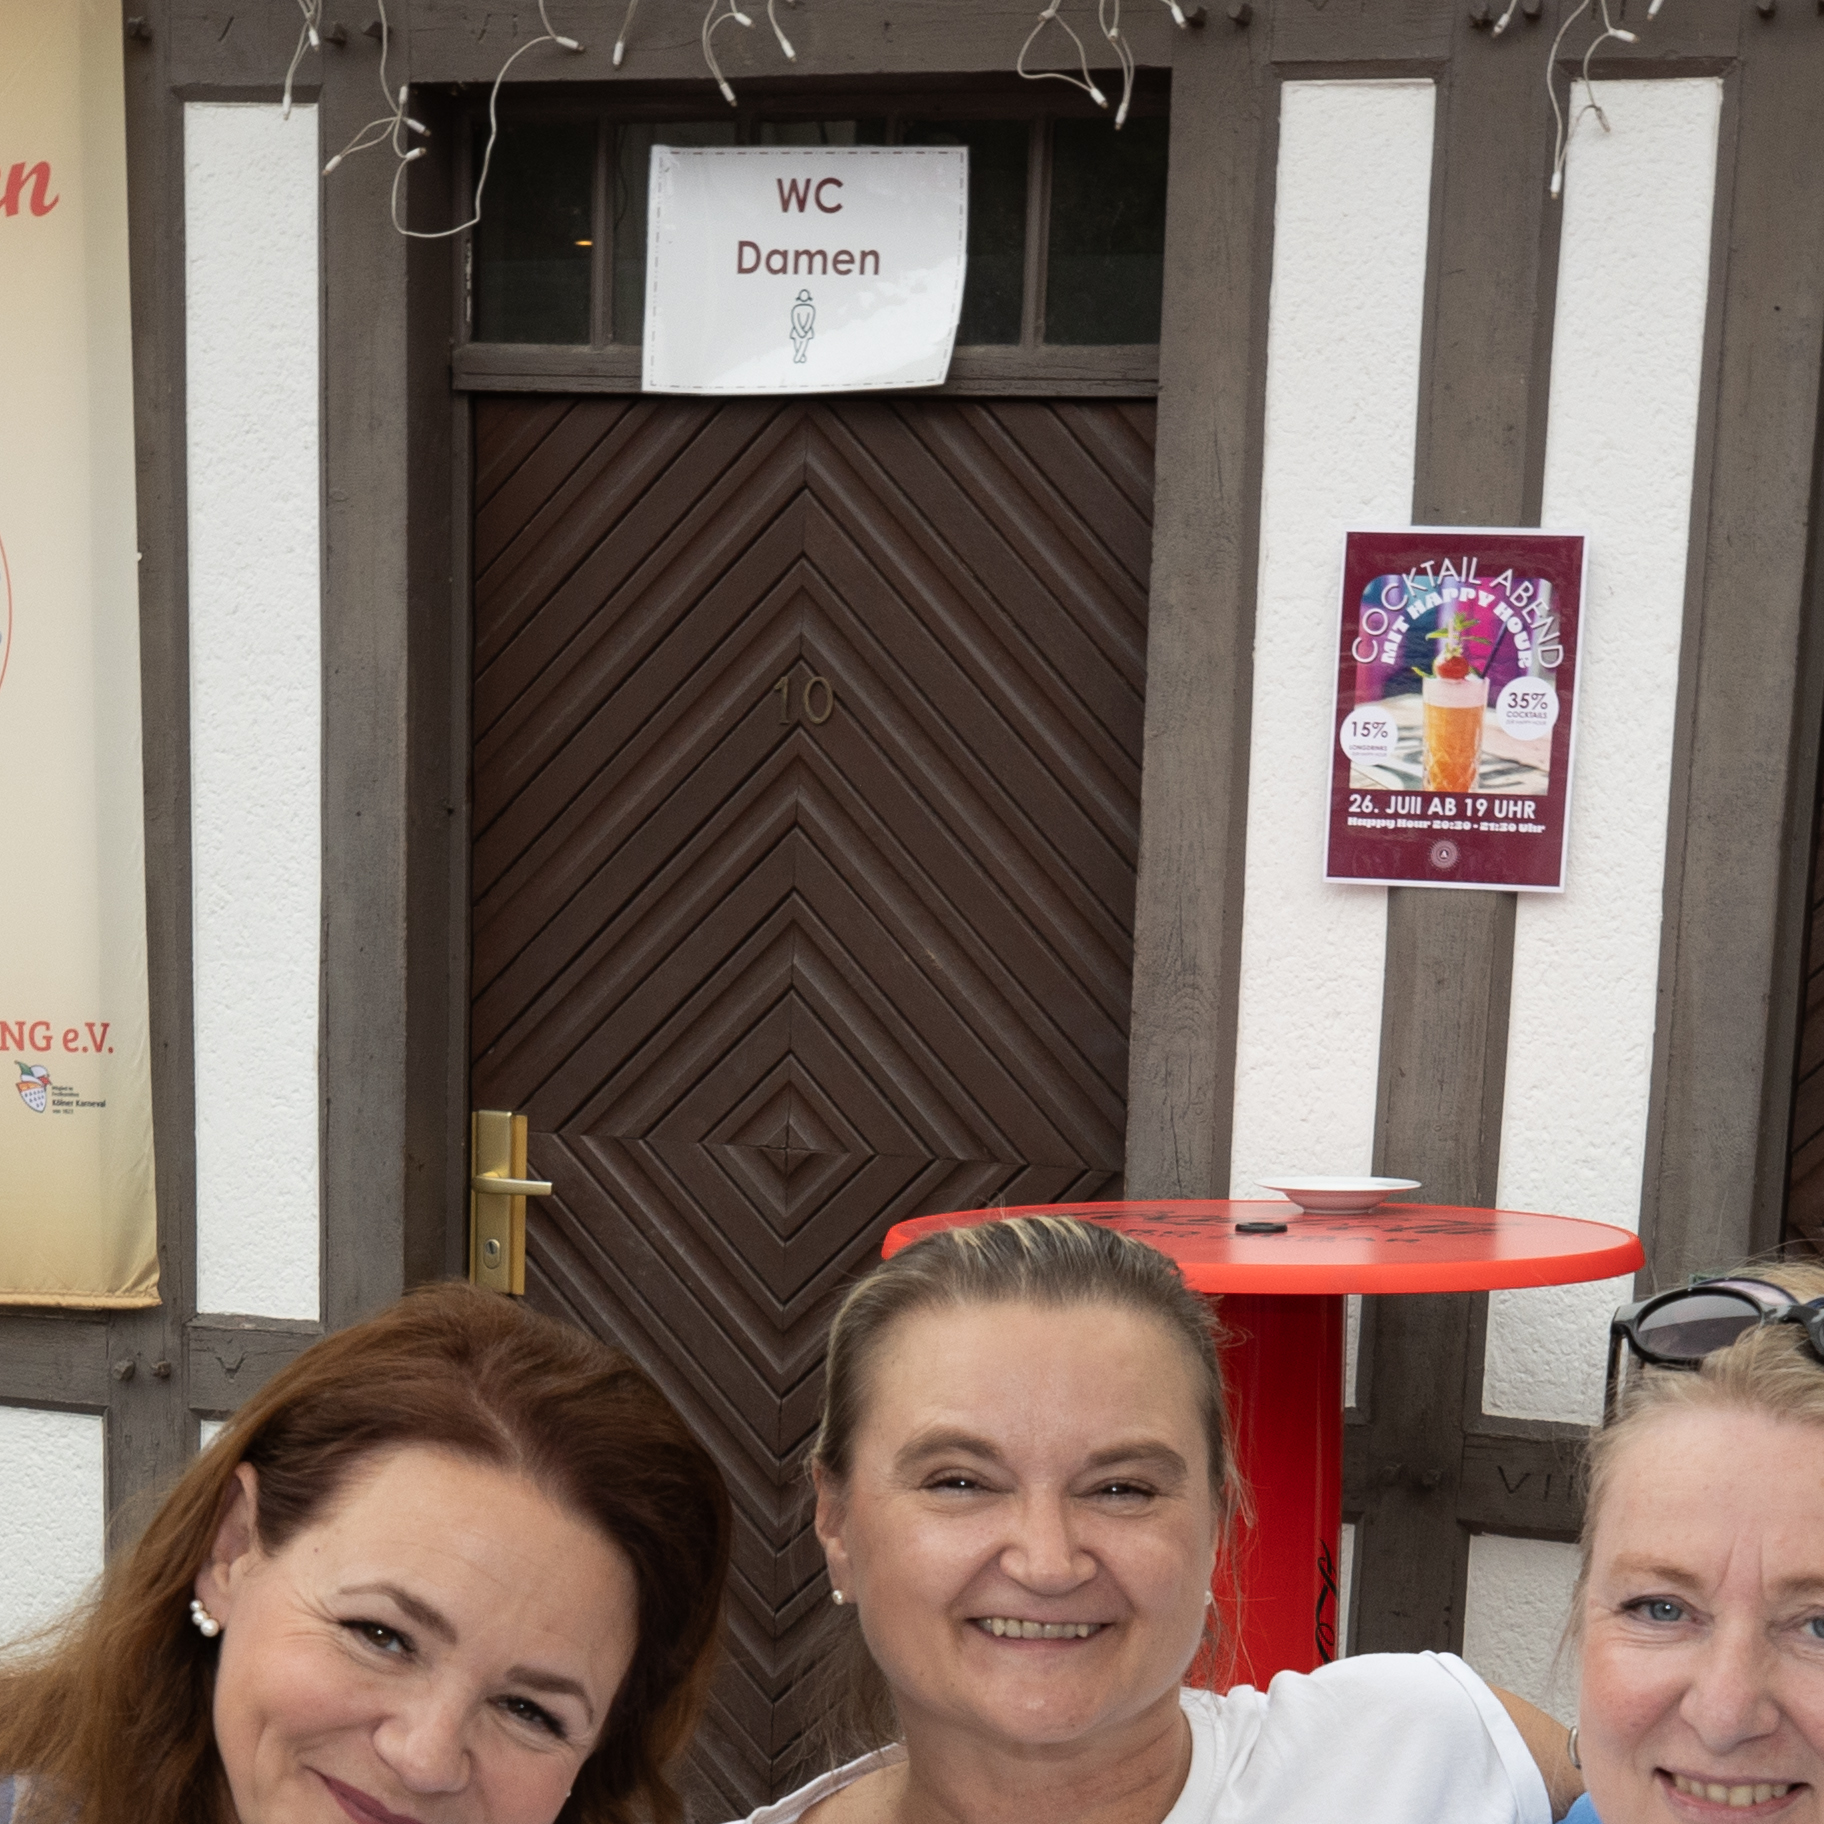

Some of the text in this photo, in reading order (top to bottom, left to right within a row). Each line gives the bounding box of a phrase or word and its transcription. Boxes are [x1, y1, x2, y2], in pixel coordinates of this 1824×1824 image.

[777, 177, 843, 214] WC
[736, 240, 880, 276] Damen
[1351, 556, 1564, 669] COCKTAIL ABEND
[1380, 587, 1532, 668] MIT HAPPY HOUR
[774, 676, 834, 725] 10
[1507, 691, 1549, 711] 35%
[1350, 721, 1389, 739] 15%
[1347, 816, 1395, 829] Happy
[1348, 794, 1379, 813] 26.
[1427, 797, 1457, 816] AB
[1464, 799, 1488, 818] 19
[1493, 800, 1536, 819] UHR
[61, 1023, 114, 1054] e.V.
